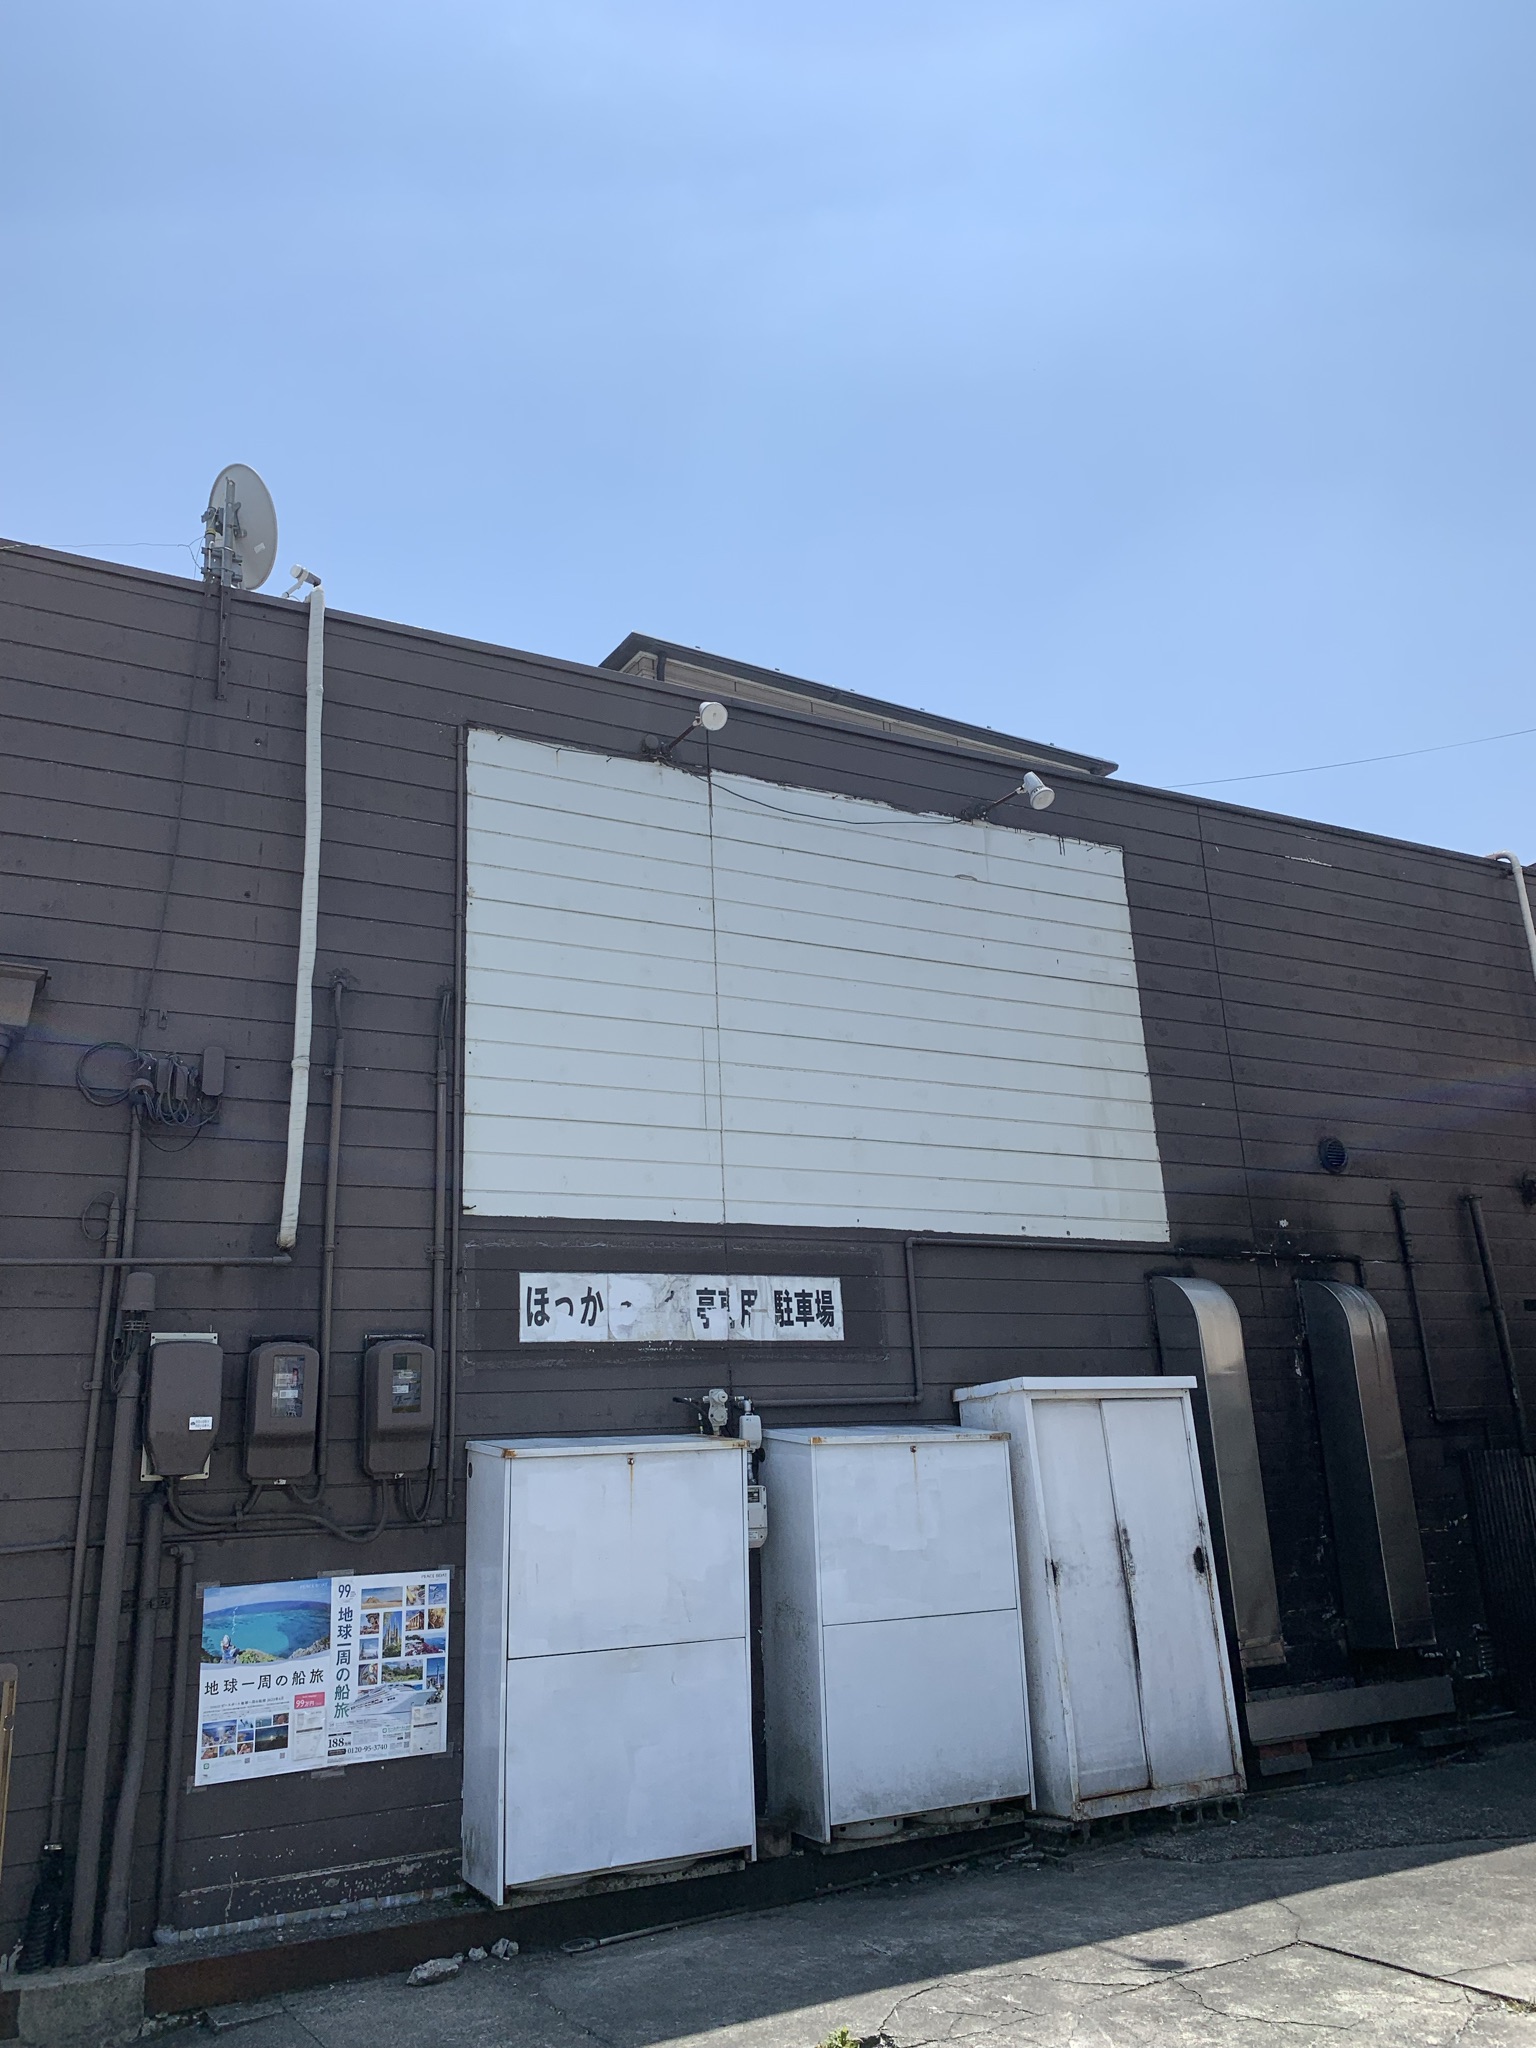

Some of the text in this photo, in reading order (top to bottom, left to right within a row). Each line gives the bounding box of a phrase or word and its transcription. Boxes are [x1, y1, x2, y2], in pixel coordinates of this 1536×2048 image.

[773, 1288, 836, 1329] 駐車場
[338, 1584, 352, 1599] 99
[334, 1606, 354, 1719] 地球一周の船旅
[204, 1668, 325, 1696] 地球一周の船旅
